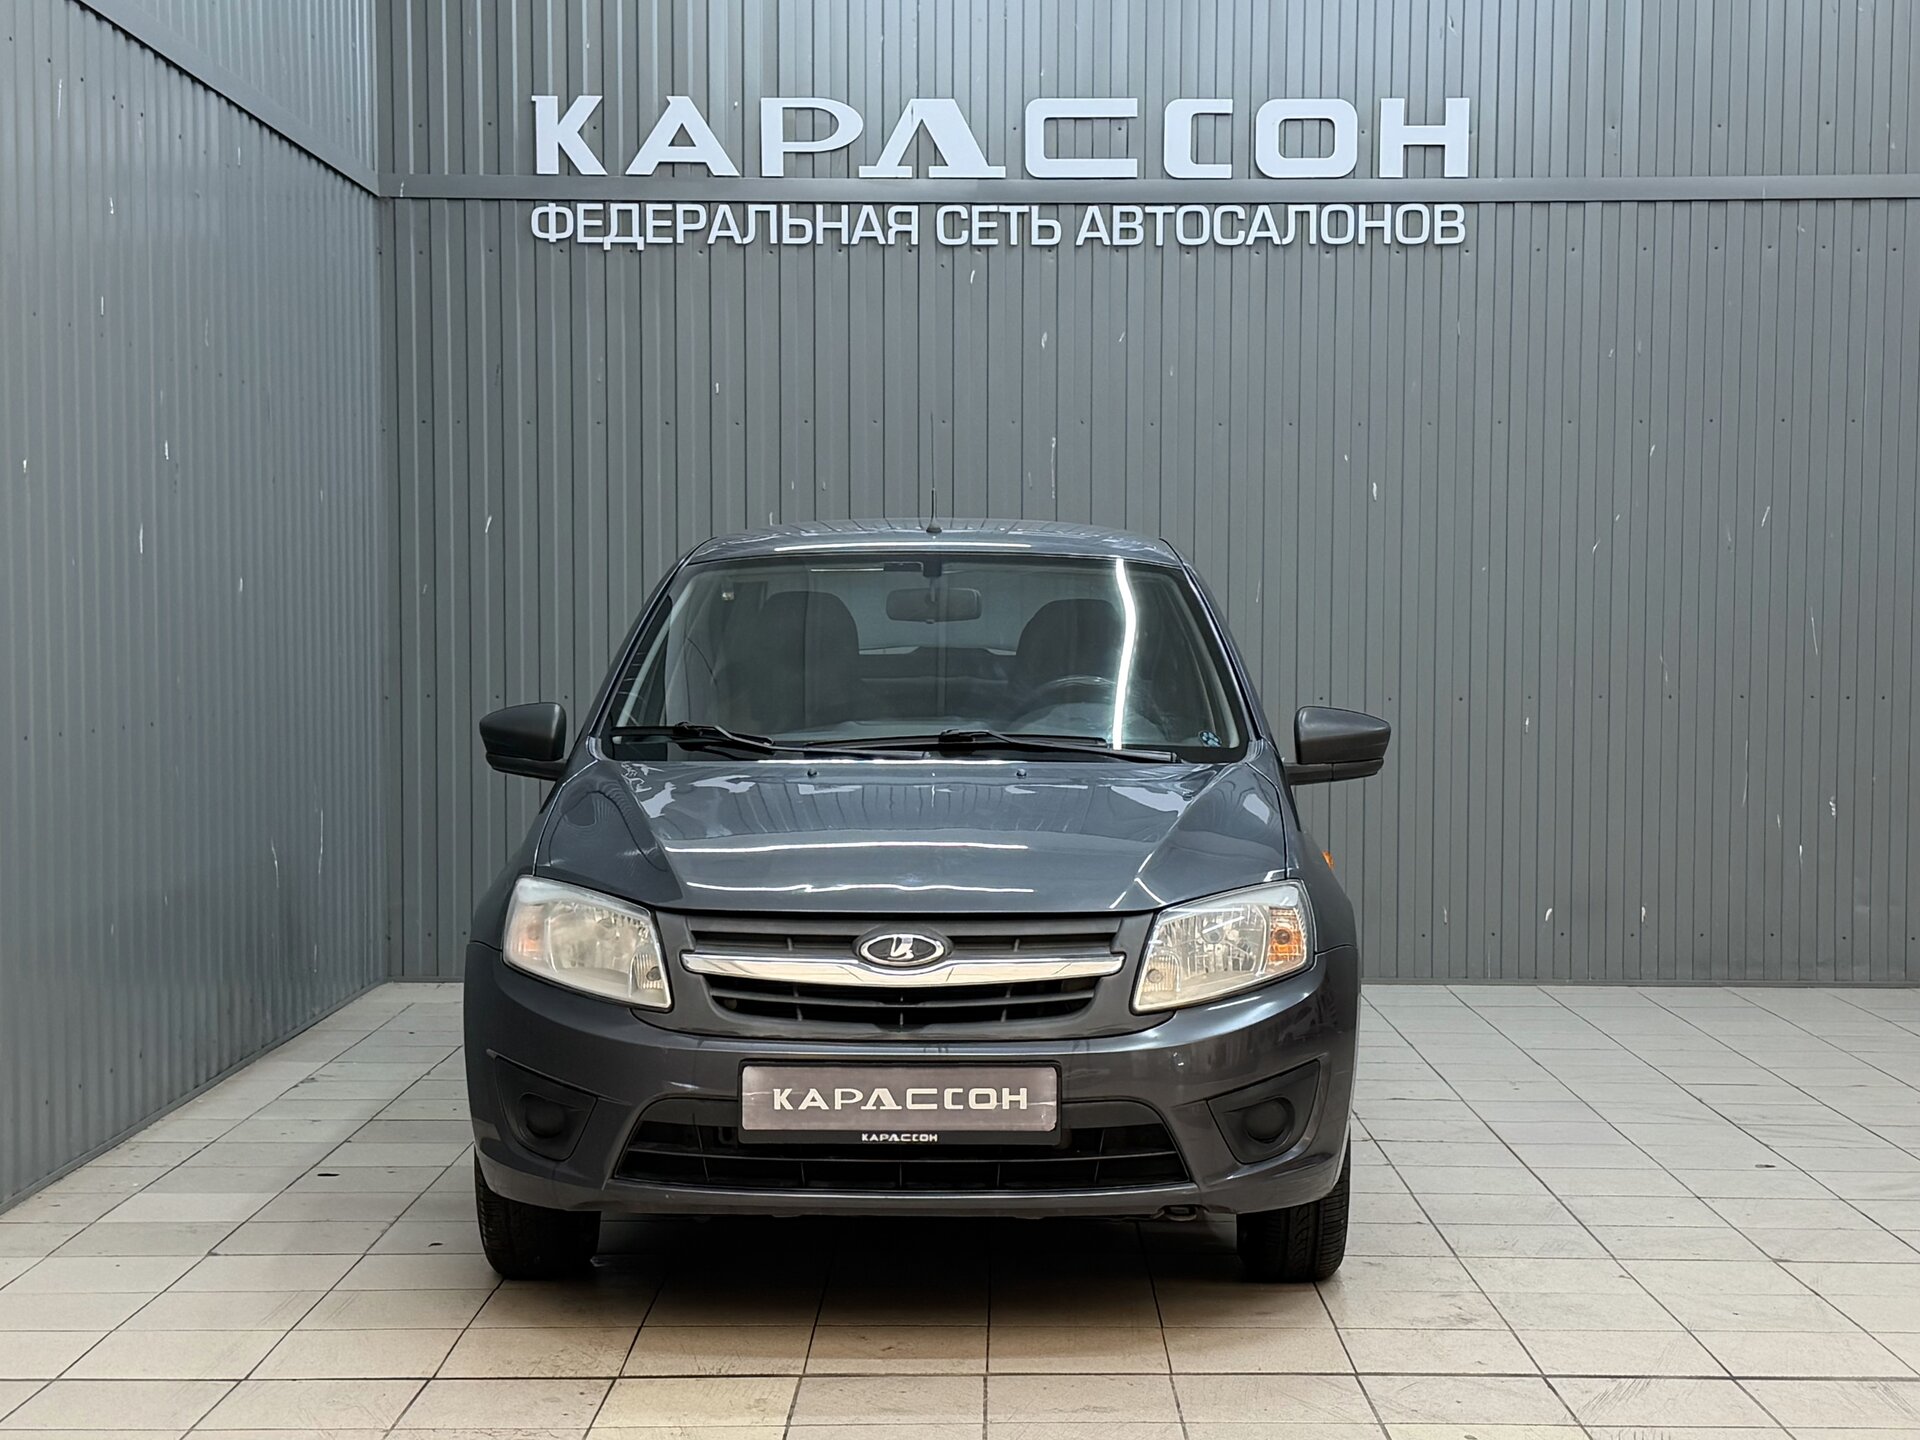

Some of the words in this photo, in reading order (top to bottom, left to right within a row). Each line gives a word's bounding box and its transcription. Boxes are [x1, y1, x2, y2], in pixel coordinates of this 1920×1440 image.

[531, 95, 1470, 179] КАРАССОН
[531, 202, 918, 250] ФЕДЕРАЛЬНАЯ
[936, 204, 1062, 247] СЕТЬ
[1075, 203, 1466, 246] АВТОСАЛОНОВ
[772, 1088, 1028, 1110] КАРАССОН
